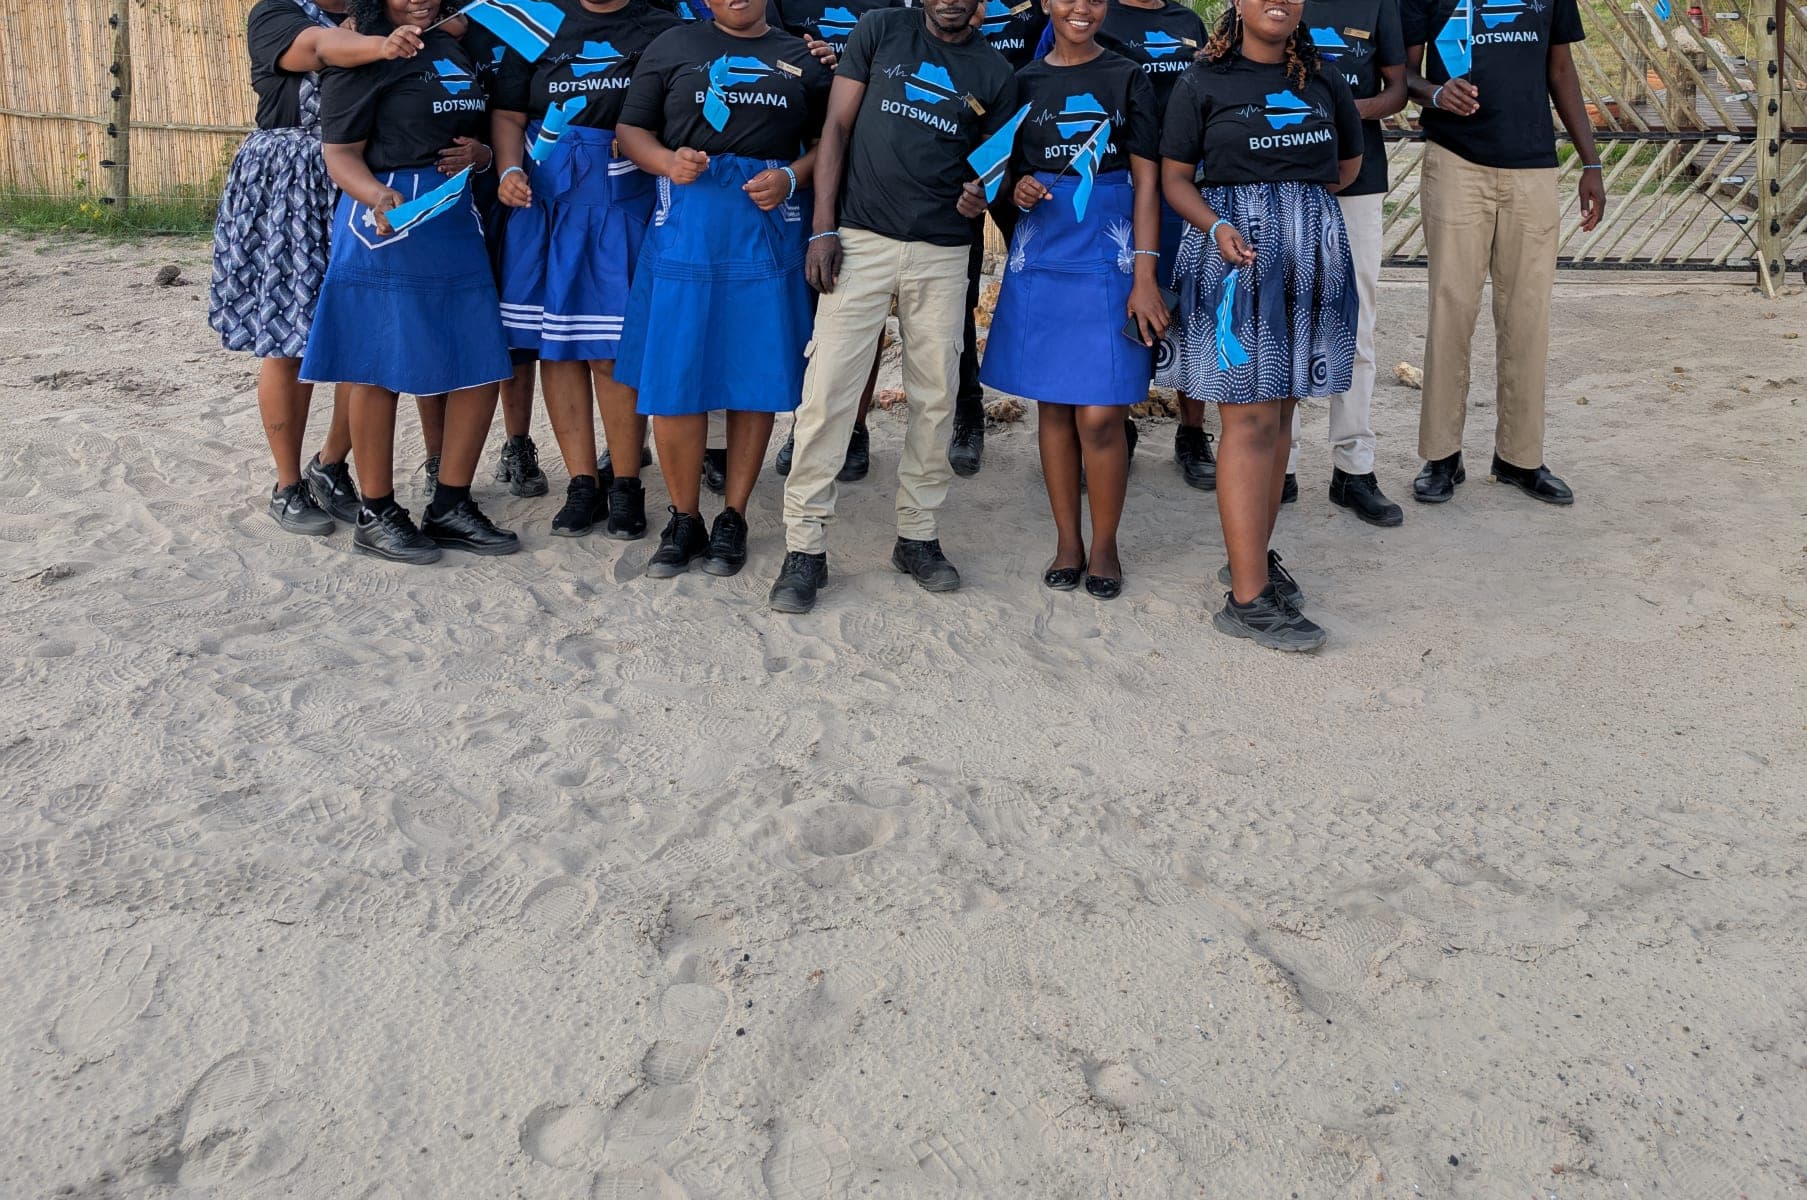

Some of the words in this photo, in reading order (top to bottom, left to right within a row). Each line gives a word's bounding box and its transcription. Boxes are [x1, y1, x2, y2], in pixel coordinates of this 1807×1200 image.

[432, 99, 486, 114] BOTSWAN
[695, 91, 788, 108] BTSWANA
[881, 99, 958, 135] BOTSWANA
[1248, 128, 1333, 150] BOTSWANA
[1045, 143, 1117, 159] BOTSNA
